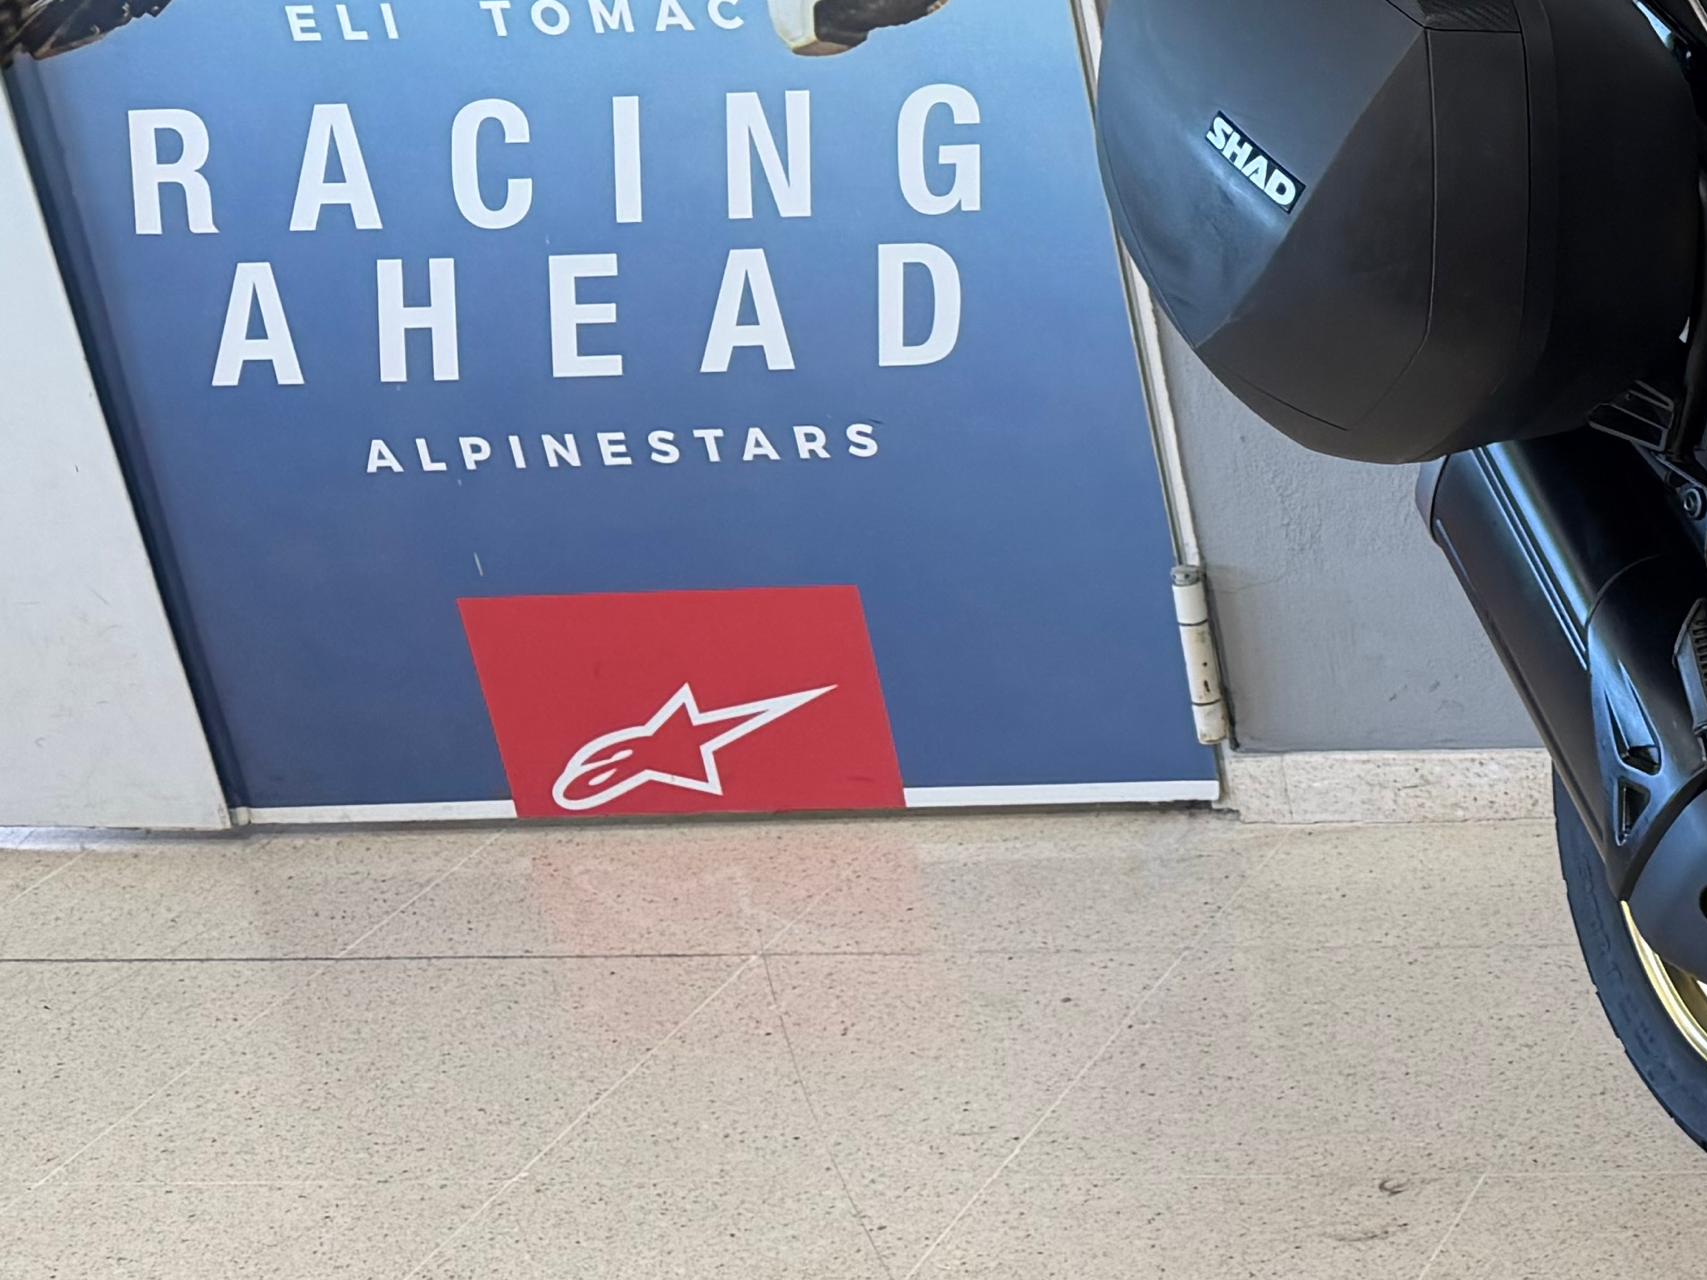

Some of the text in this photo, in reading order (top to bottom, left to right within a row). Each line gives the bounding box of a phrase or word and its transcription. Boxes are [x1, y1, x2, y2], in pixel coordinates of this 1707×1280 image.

[285, 3, 400, 42] ELI
[127, 83, 983, 235] RACING
[1205, 115, 1298, 207] SHAD
[211, 242, 963, 387] AHEAD
[366, 422, 880, 474] ALPINESTARS
